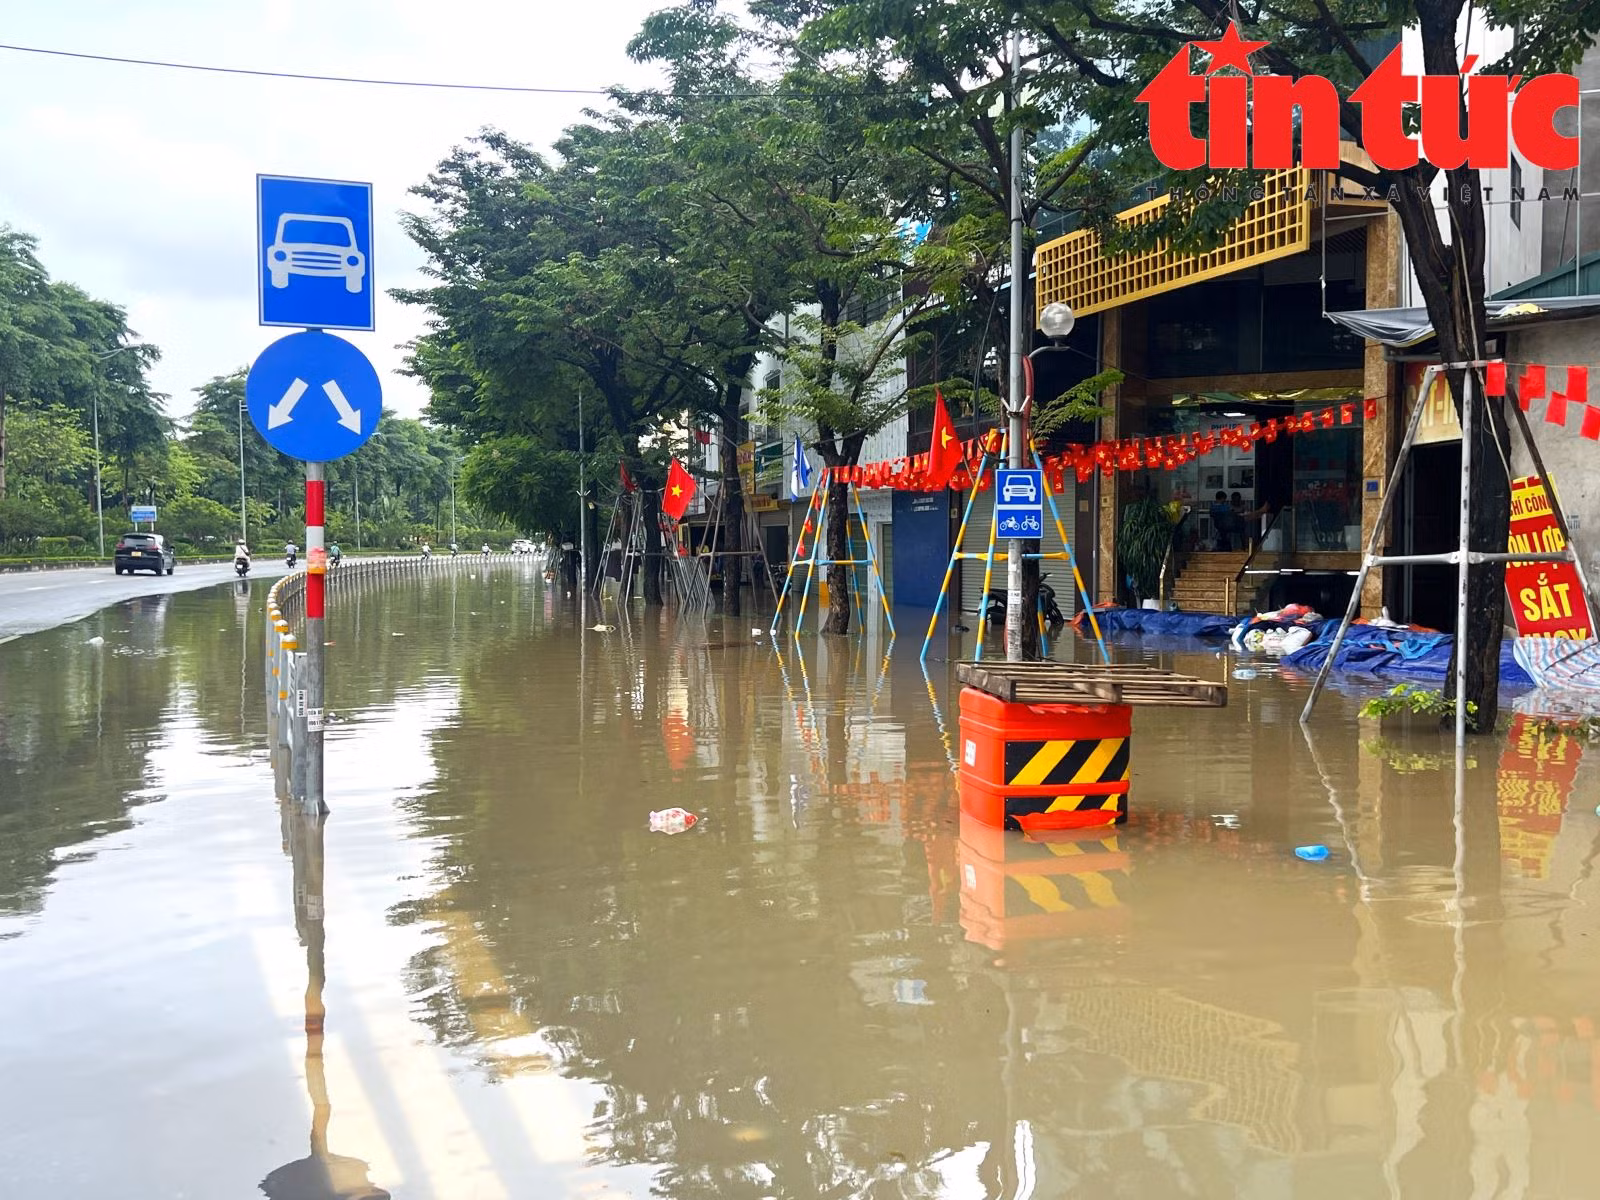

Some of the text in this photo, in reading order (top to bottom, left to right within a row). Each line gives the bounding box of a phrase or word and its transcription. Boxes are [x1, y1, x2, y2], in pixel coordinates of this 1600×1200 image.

[1510, 495, 1524, 516] HÍ
[1506, 529, 1535, 568] ÔN
[1519, 572, 1573, 622] SẮT
